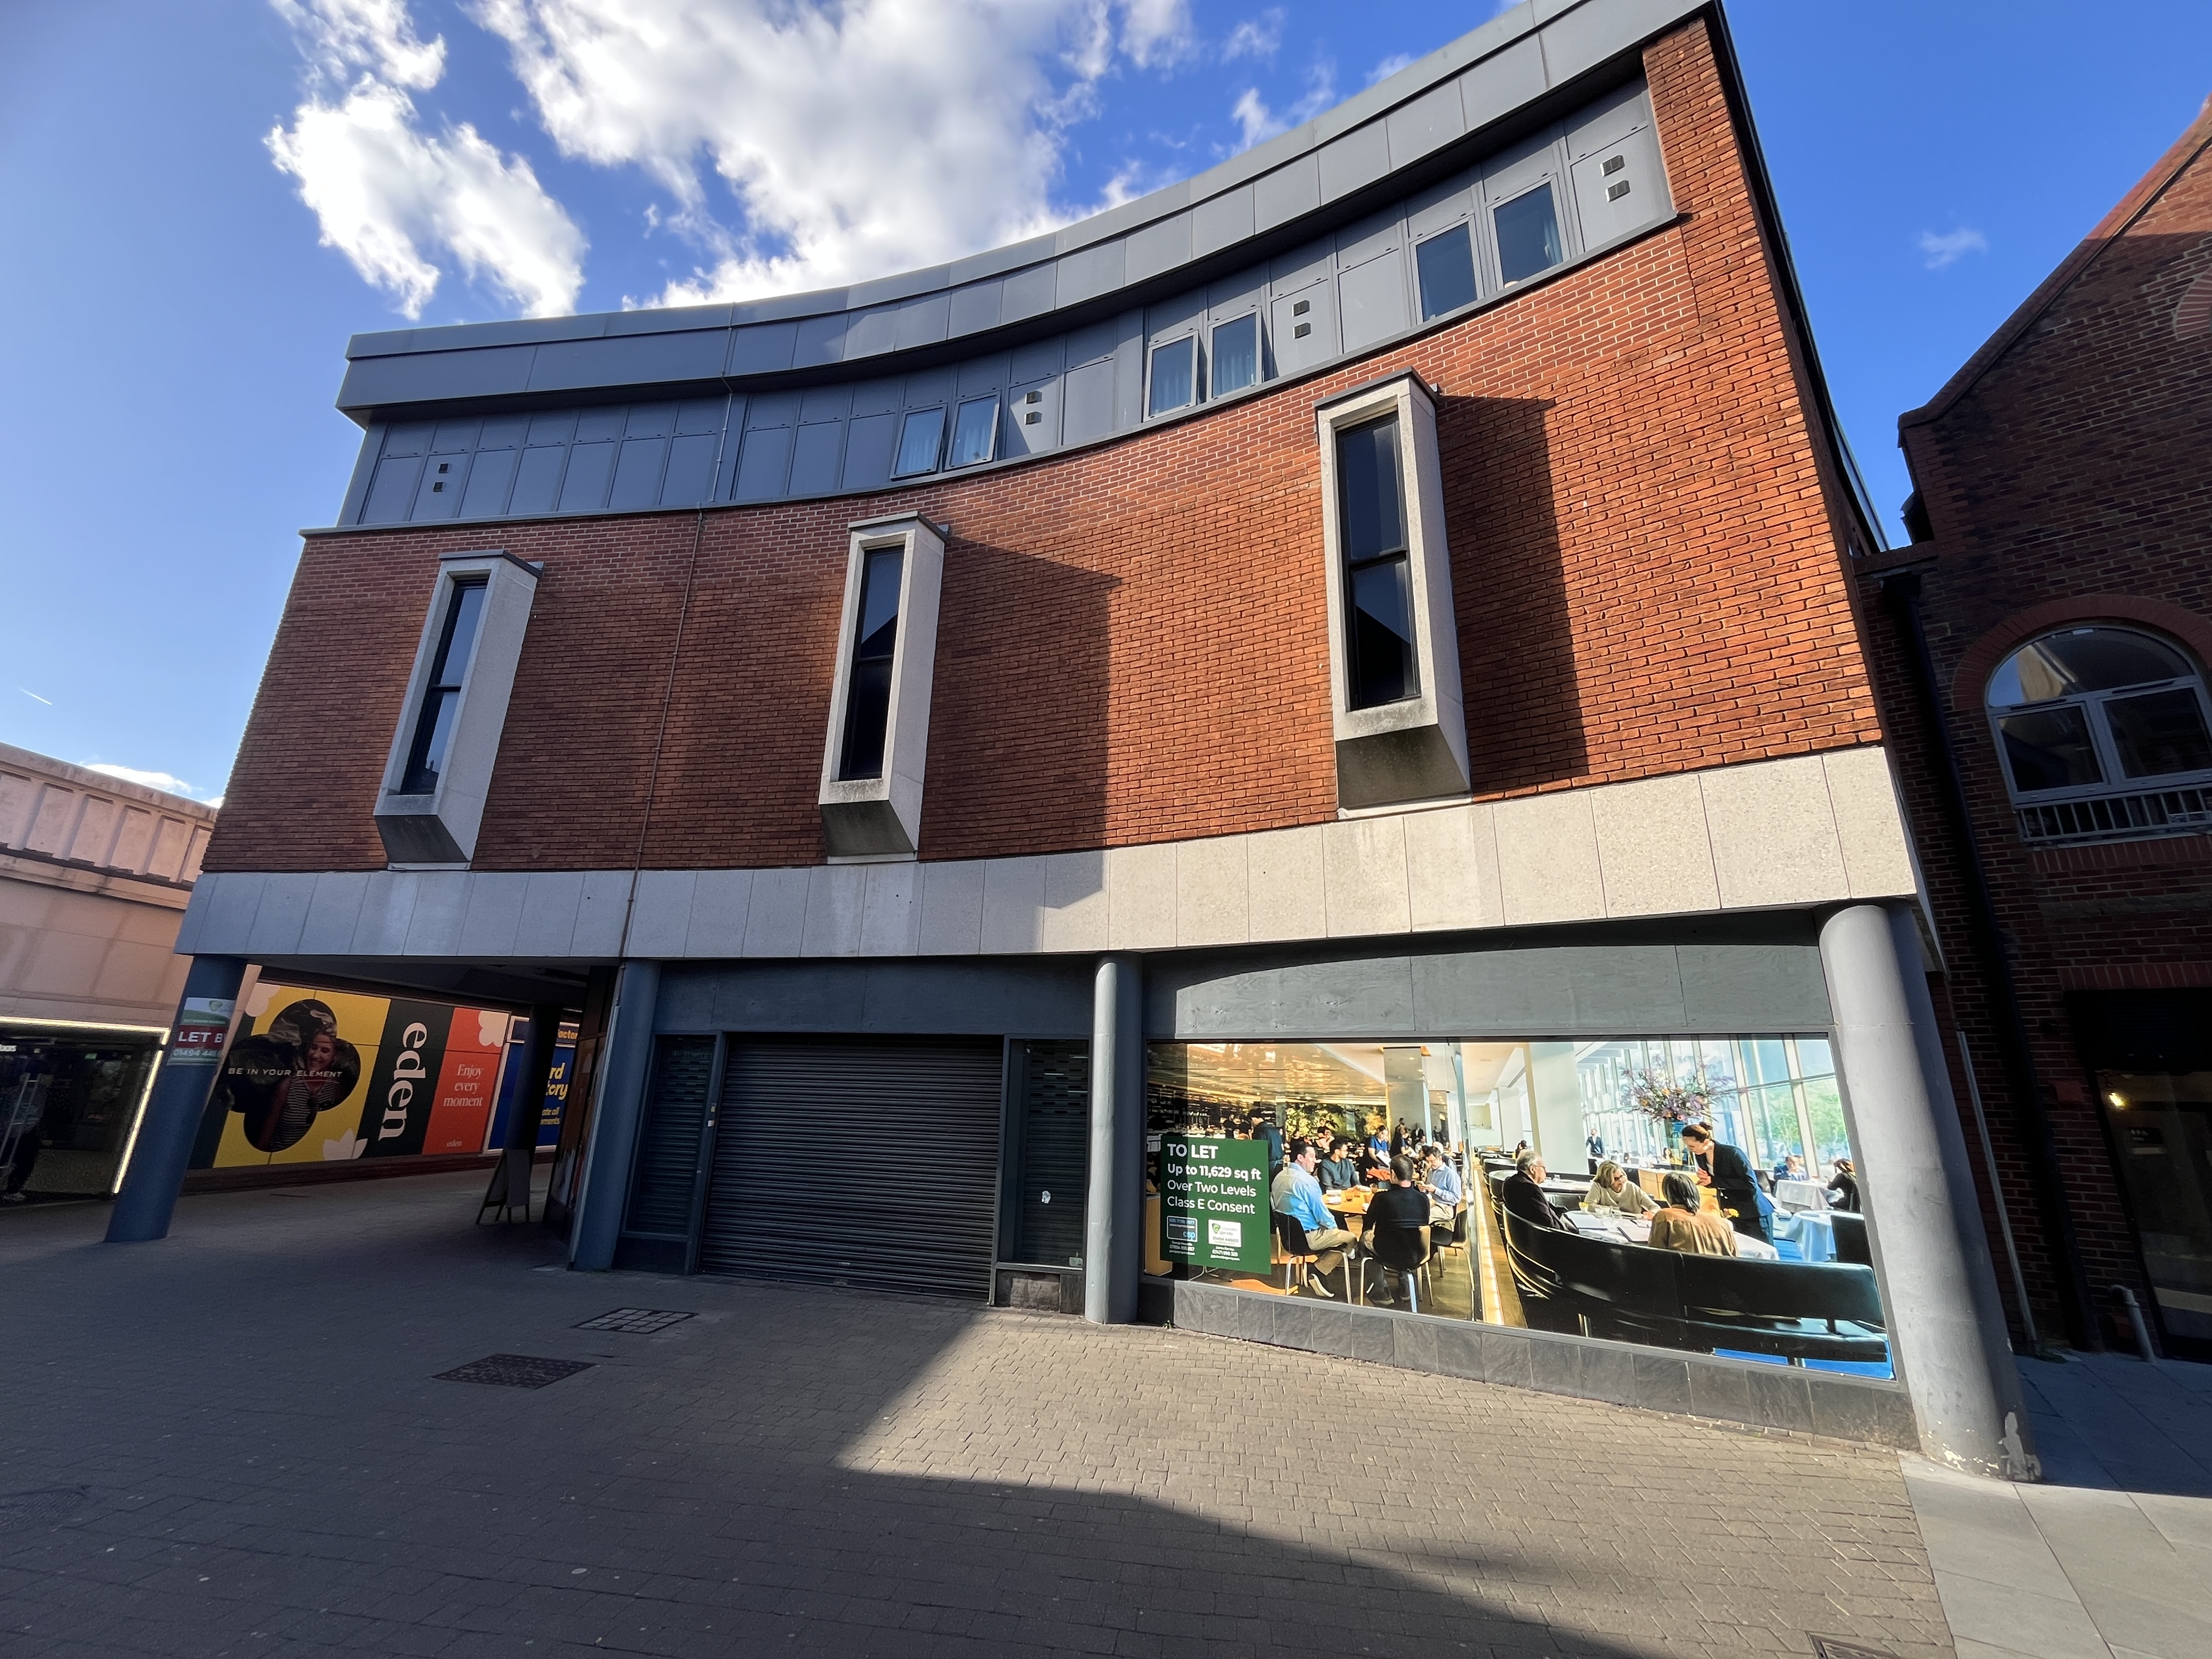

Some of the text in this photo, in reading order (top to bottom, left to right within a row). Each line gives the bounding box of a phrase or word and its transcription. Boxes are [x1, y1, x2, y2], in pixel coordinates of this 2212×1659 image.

[178, 1031, 226, 1043] LET B
[557, 1029, 578, 1040] actor
[457, 1064, 484, 1078] Enjoy
[378, 1022, 427, 1141] eden
[454, 1081, 480, 1094] every
[443, 1097, 483, 1107] moment
[1167, 1143, 1218, 1159] TO LET
[1167, 1164, 1262, 1182] Up to 11,629 sq ft
[1167, 1180, 1256, 1197] Over Two Levels
[1167, 1196, 1255, 1215] Class E Consent
